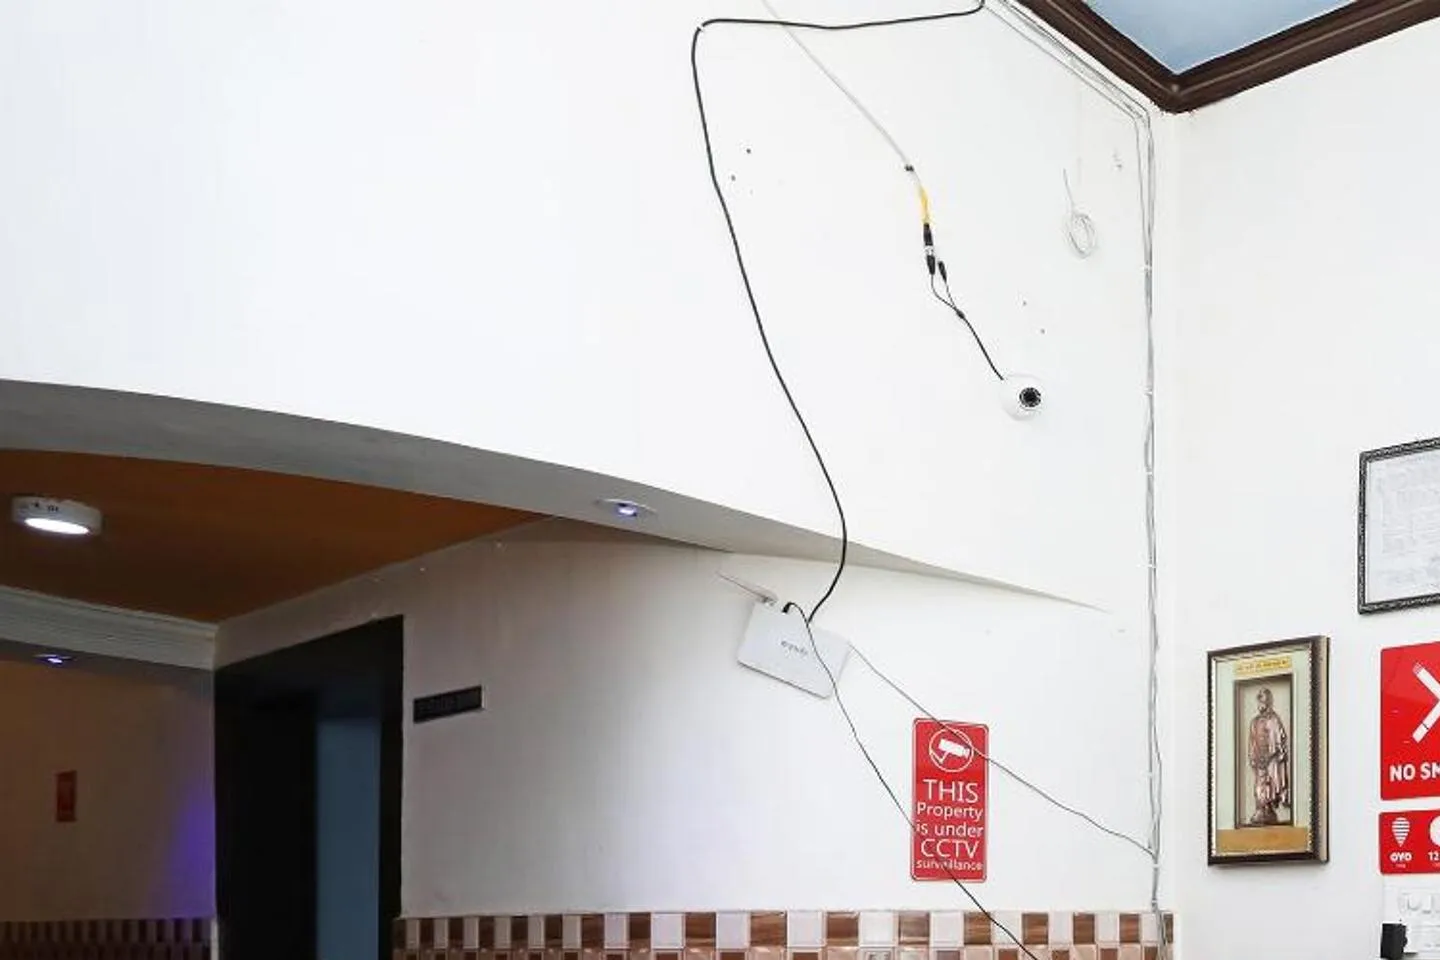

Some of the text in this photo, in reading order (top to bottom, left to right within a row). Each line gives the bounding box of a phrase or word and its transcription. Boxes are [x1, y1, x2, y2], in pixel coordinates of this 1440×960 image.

[1389, 764, 1415, 782] NO
[922, 778, 980, 804] THIS
[916, 802, 984, 822] Property
[915, 820, 984, 838] is under
[920, 838, 980, 859] CCTV
[1389, 851, 1413, 862] OYO
